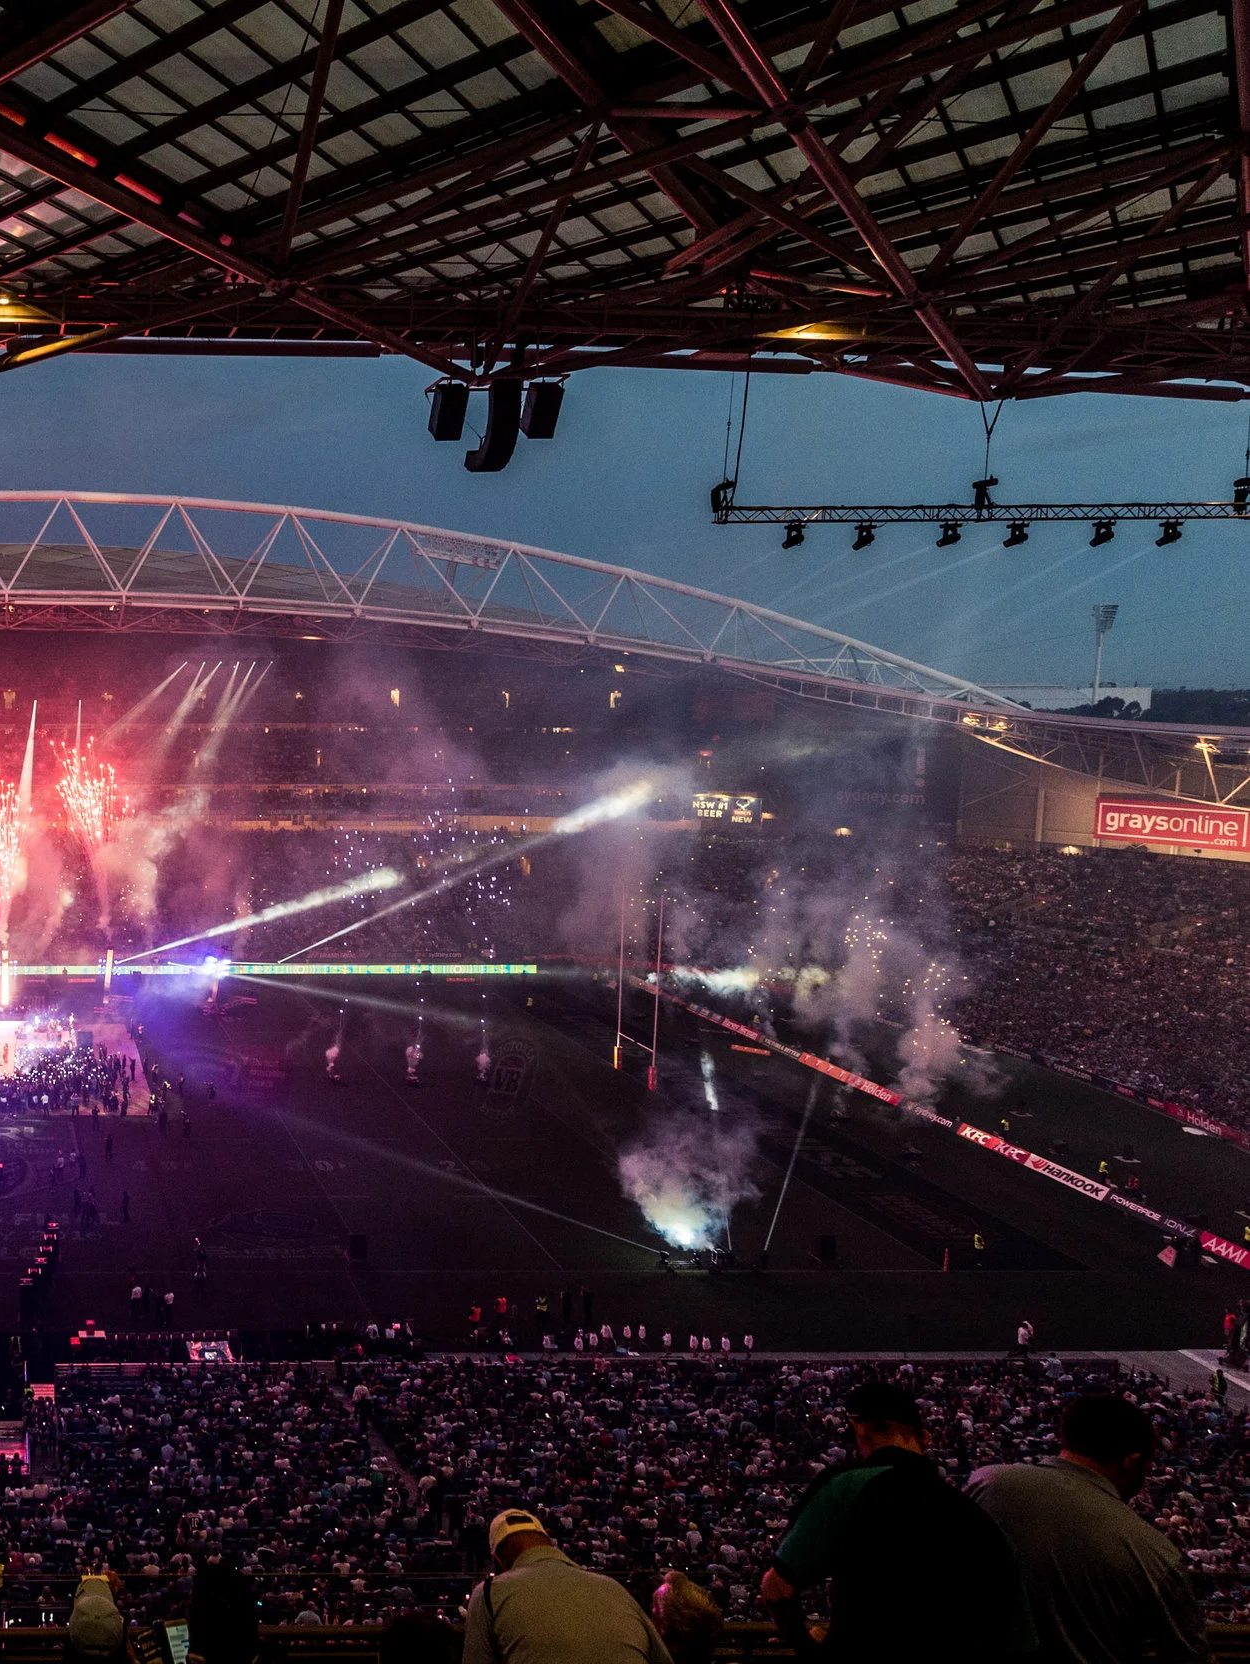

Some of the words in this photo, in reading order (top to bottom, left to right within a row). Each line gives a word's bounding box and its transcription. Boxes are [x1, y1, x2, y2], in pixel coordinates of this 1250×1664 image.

[692, 801, 716, 809] NSW
[718, 802, 729, 810] #1
[836, 790, 926, 805] sydney.com
[697, 809, 723, 818] BEER
[731, 816, 753, 824] NEW
[1105, 811, 1239, 837] graysonline
[1210, 839, 1238, 847] .com
[861, 1080, 892, 1102] Holden
[915, 1105, 953, 1128] sydney.com
[1186, 1111, 1222, 1136] Holden
[960, 1126, 992, 1145] KFC
[993, 1141, 1026, 1160] KFC
[13, 1213, 121, 1226] FINL
[1110, 1194, 1162, 1222] POWERADE
[1163, 1218, 1197, 1238] ION4
[1202, 1237, 1248, 1264] AAMI
